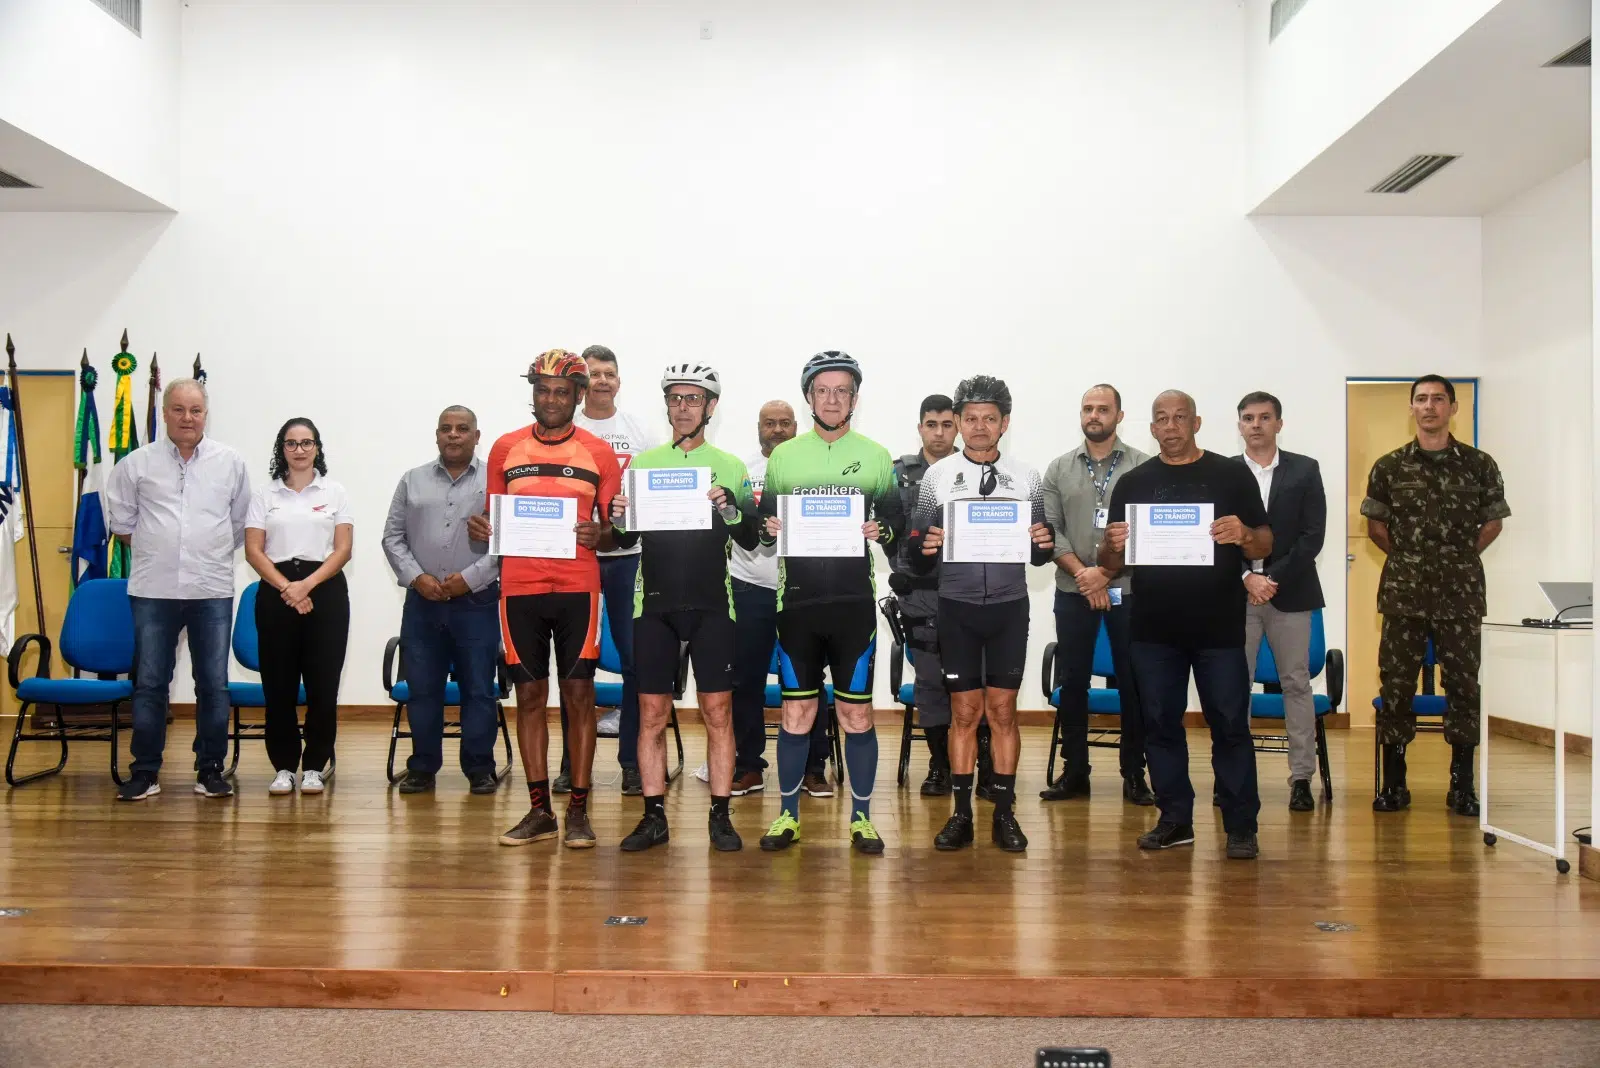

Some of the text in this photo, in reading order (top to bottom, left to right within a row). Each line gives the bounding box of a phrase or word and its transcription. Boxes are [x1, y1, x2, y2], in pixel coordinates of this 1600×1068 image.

[609, 441, 630, 450] ITO
[507, 466, 539, 476] CYCLING
[792, 484, 862, 495] Ecobikers
